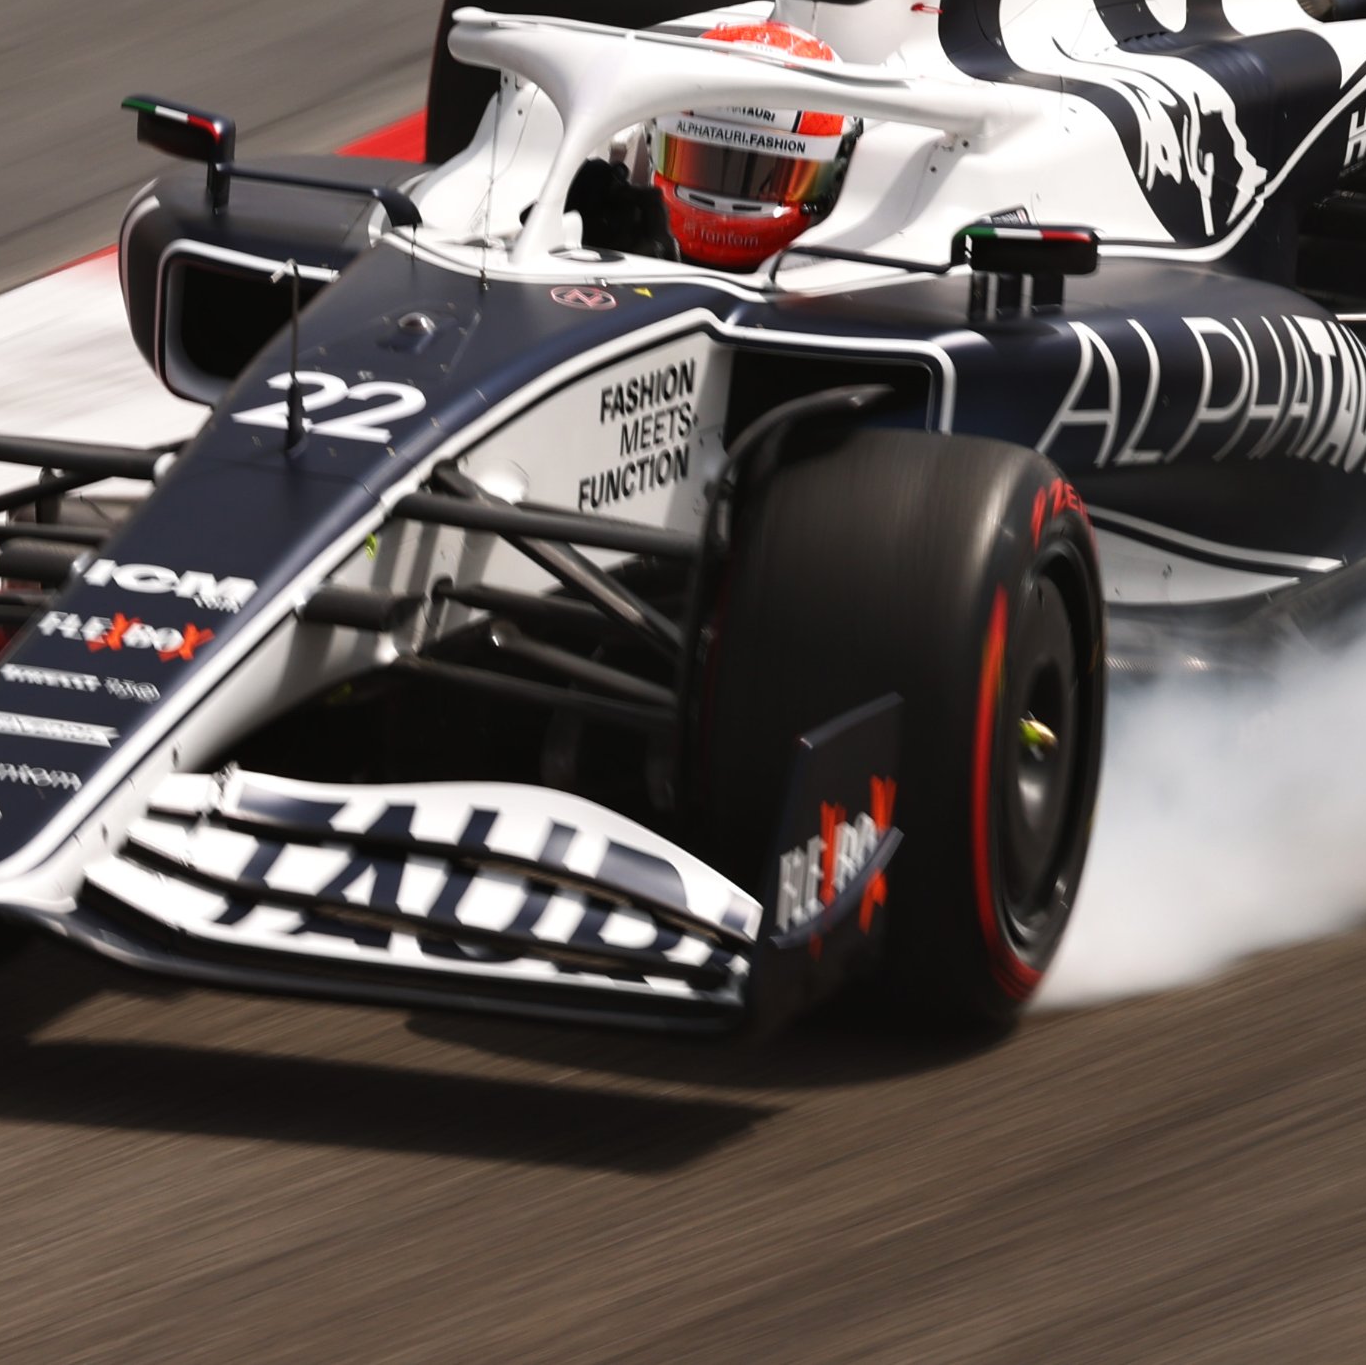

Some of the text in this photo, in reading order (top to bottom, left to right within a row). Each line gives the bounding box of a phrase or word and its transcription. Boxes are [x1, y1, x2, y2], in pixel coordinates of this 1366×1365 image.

[230, 370, 427, 444] 22
[599, 357, 696, 426] FASHION
[619, 400, 692, 457] MEETS
[577, 442, 690, 512] FUNCTION
